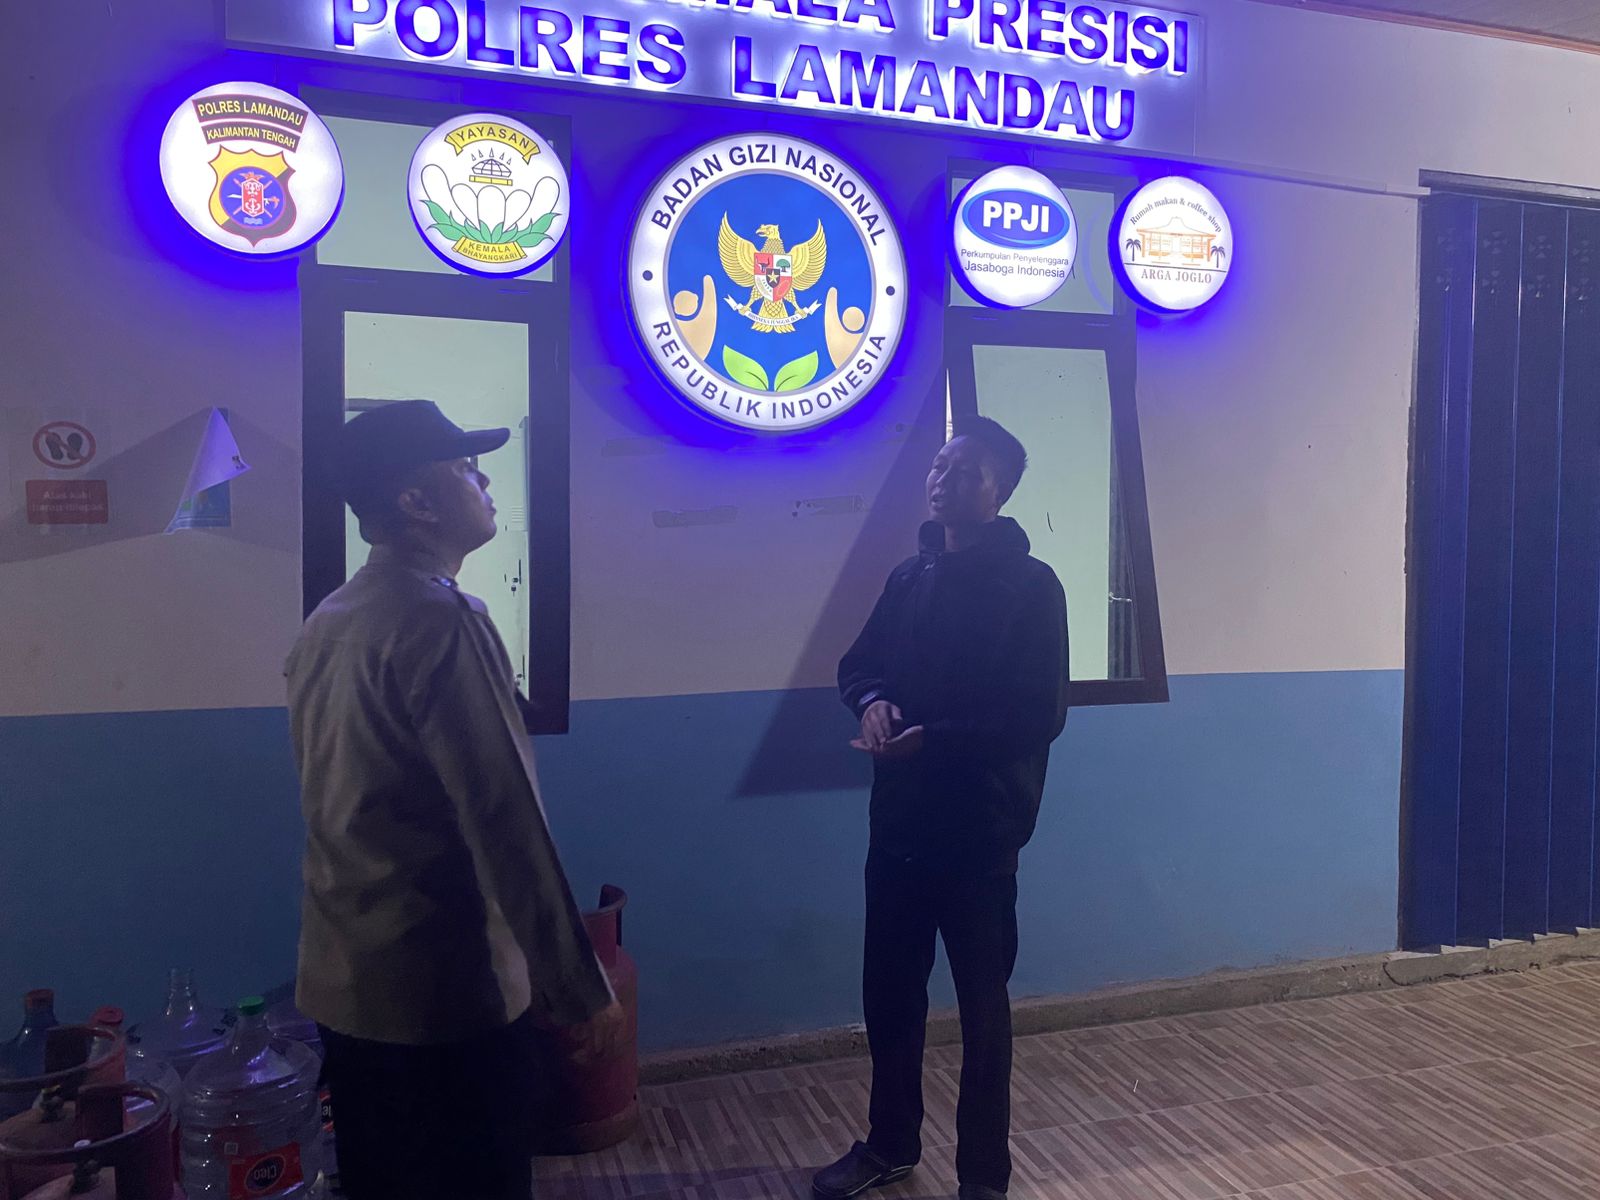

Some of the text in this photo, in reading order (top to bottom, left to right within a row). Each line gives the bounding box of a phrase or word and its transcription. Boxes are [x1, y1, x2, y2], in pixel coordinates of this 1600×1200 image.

[930, 0, 1189, 75] PRESISI
[333, 0, 1137, 142] POLRES LAMANDAU
[197, 100, 304, 126] POLRES LAMANDAU
[206, 126, 296, 148] KALIMANTAN TENGAH
[456, 126, 530, 149] YAYASAN
[651, 143, 886, 247] BADAN GIZI NASIONAL
[982, 199, 1050, 233] PPJI
[1129, 203, 1154, 226] Rumah
[1154, 196, 1178, 208] makan
[1179, 197, 1186, 206] &
[1207, 215, 1222, 234] shop
[463, 247, 518, 262] BHAYANGKARI
[468, 241, 511, 253] KEMALA
[960, 249, 1069, 267] Perkumpulan Penyelenggara
[964, 261, 1065, 278] Jasaboga Indonesia
[1141, 269, 1212, 284] ARGA JOGLO
[652, 321, 886, 419] REPUBLIK INDONESIA
